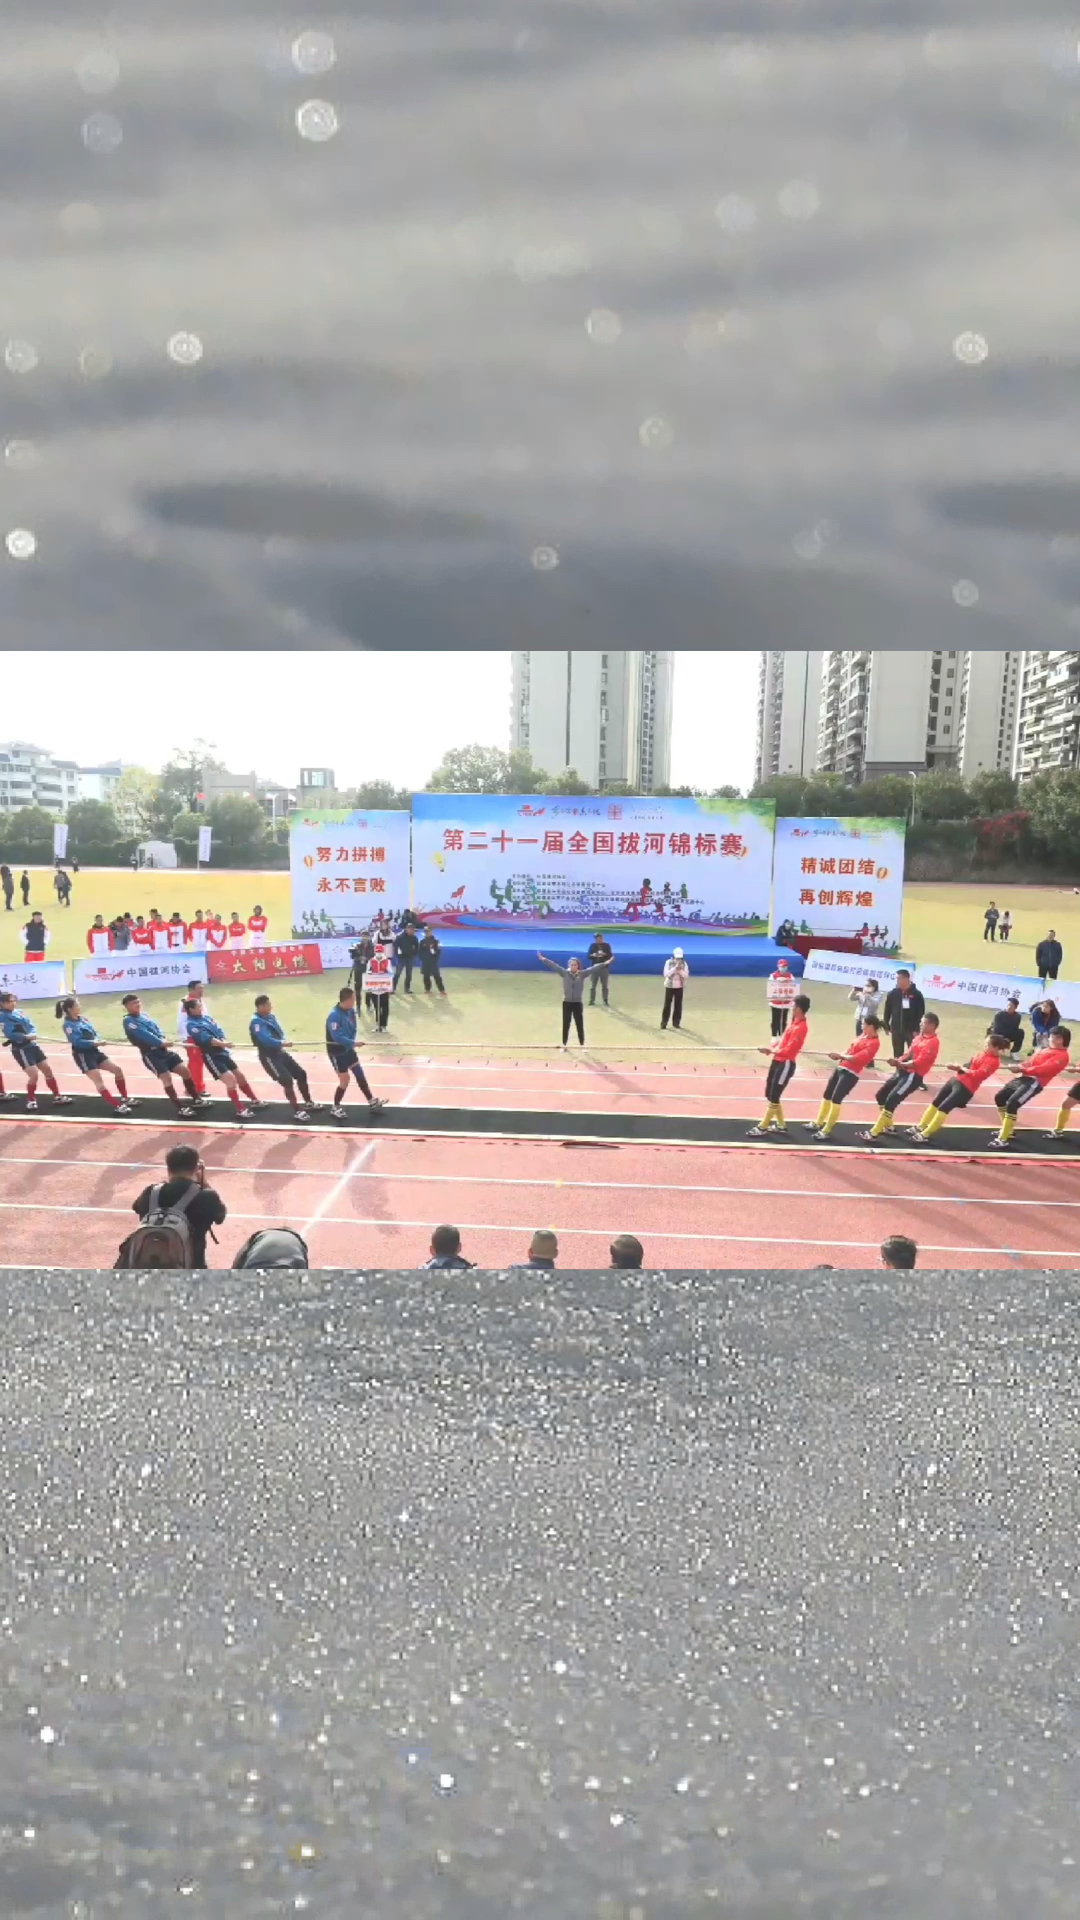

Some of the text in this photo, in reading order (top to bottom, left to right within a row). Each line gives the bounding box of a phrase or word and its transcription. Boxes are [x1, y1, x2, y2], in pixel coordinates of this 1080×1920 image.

[443, 828, 743, 856] 第二十一届全国拔河锦标赛
[316, 846, 386, 862] 努力拼搏
[800, 857, 875, 875] 精诚团结
[317, 877, 386, 893] 永不言败
[799, 888, 873, 907] 再创辉煌
[127, 964, 190, 978] 中国拔河协会
[957, 981, 1022, 999] 中国拔河协会
